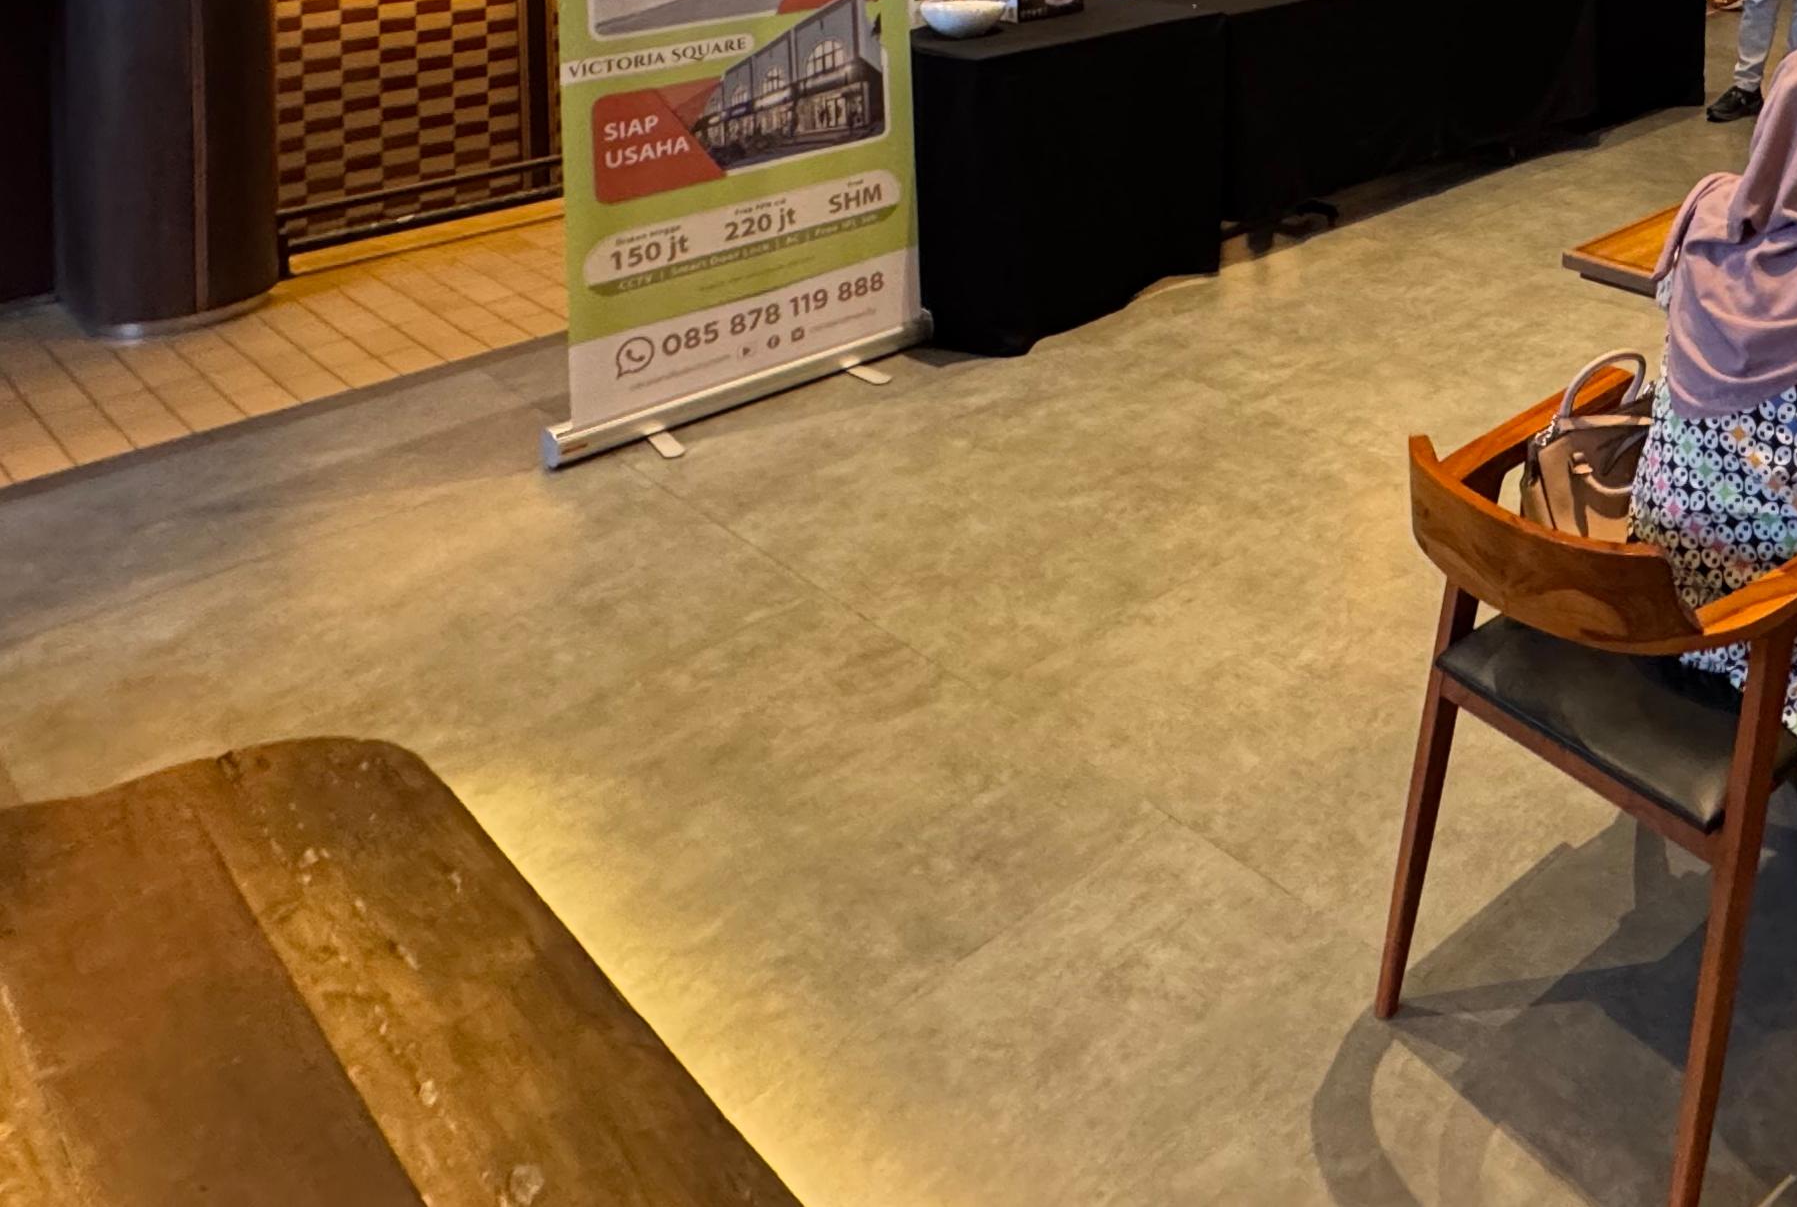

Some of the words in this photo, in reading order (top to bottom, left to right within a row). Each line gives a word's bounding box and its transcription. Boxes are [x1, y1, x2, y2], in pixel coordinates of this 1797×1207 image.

[568, 50, 665, 79] VICTORIA
[671, 37, 747, 62] SQUARE
[603, 115, 659, 142] SIAP
[605, 136, 690, 170] USAHA
[828, 183, 883, 215] SHM
[724, 214, 772, 241] 220
[777, 207, 797, 233] jt
[610, 241, 662, 271] 150
[667, 234, 689, 262] jt
[662, 321, 719, 357] 085
[730, 303, 782, 337] 878
[789, 287, 828, 319] 119
[838, 272, 884, 304] 888
